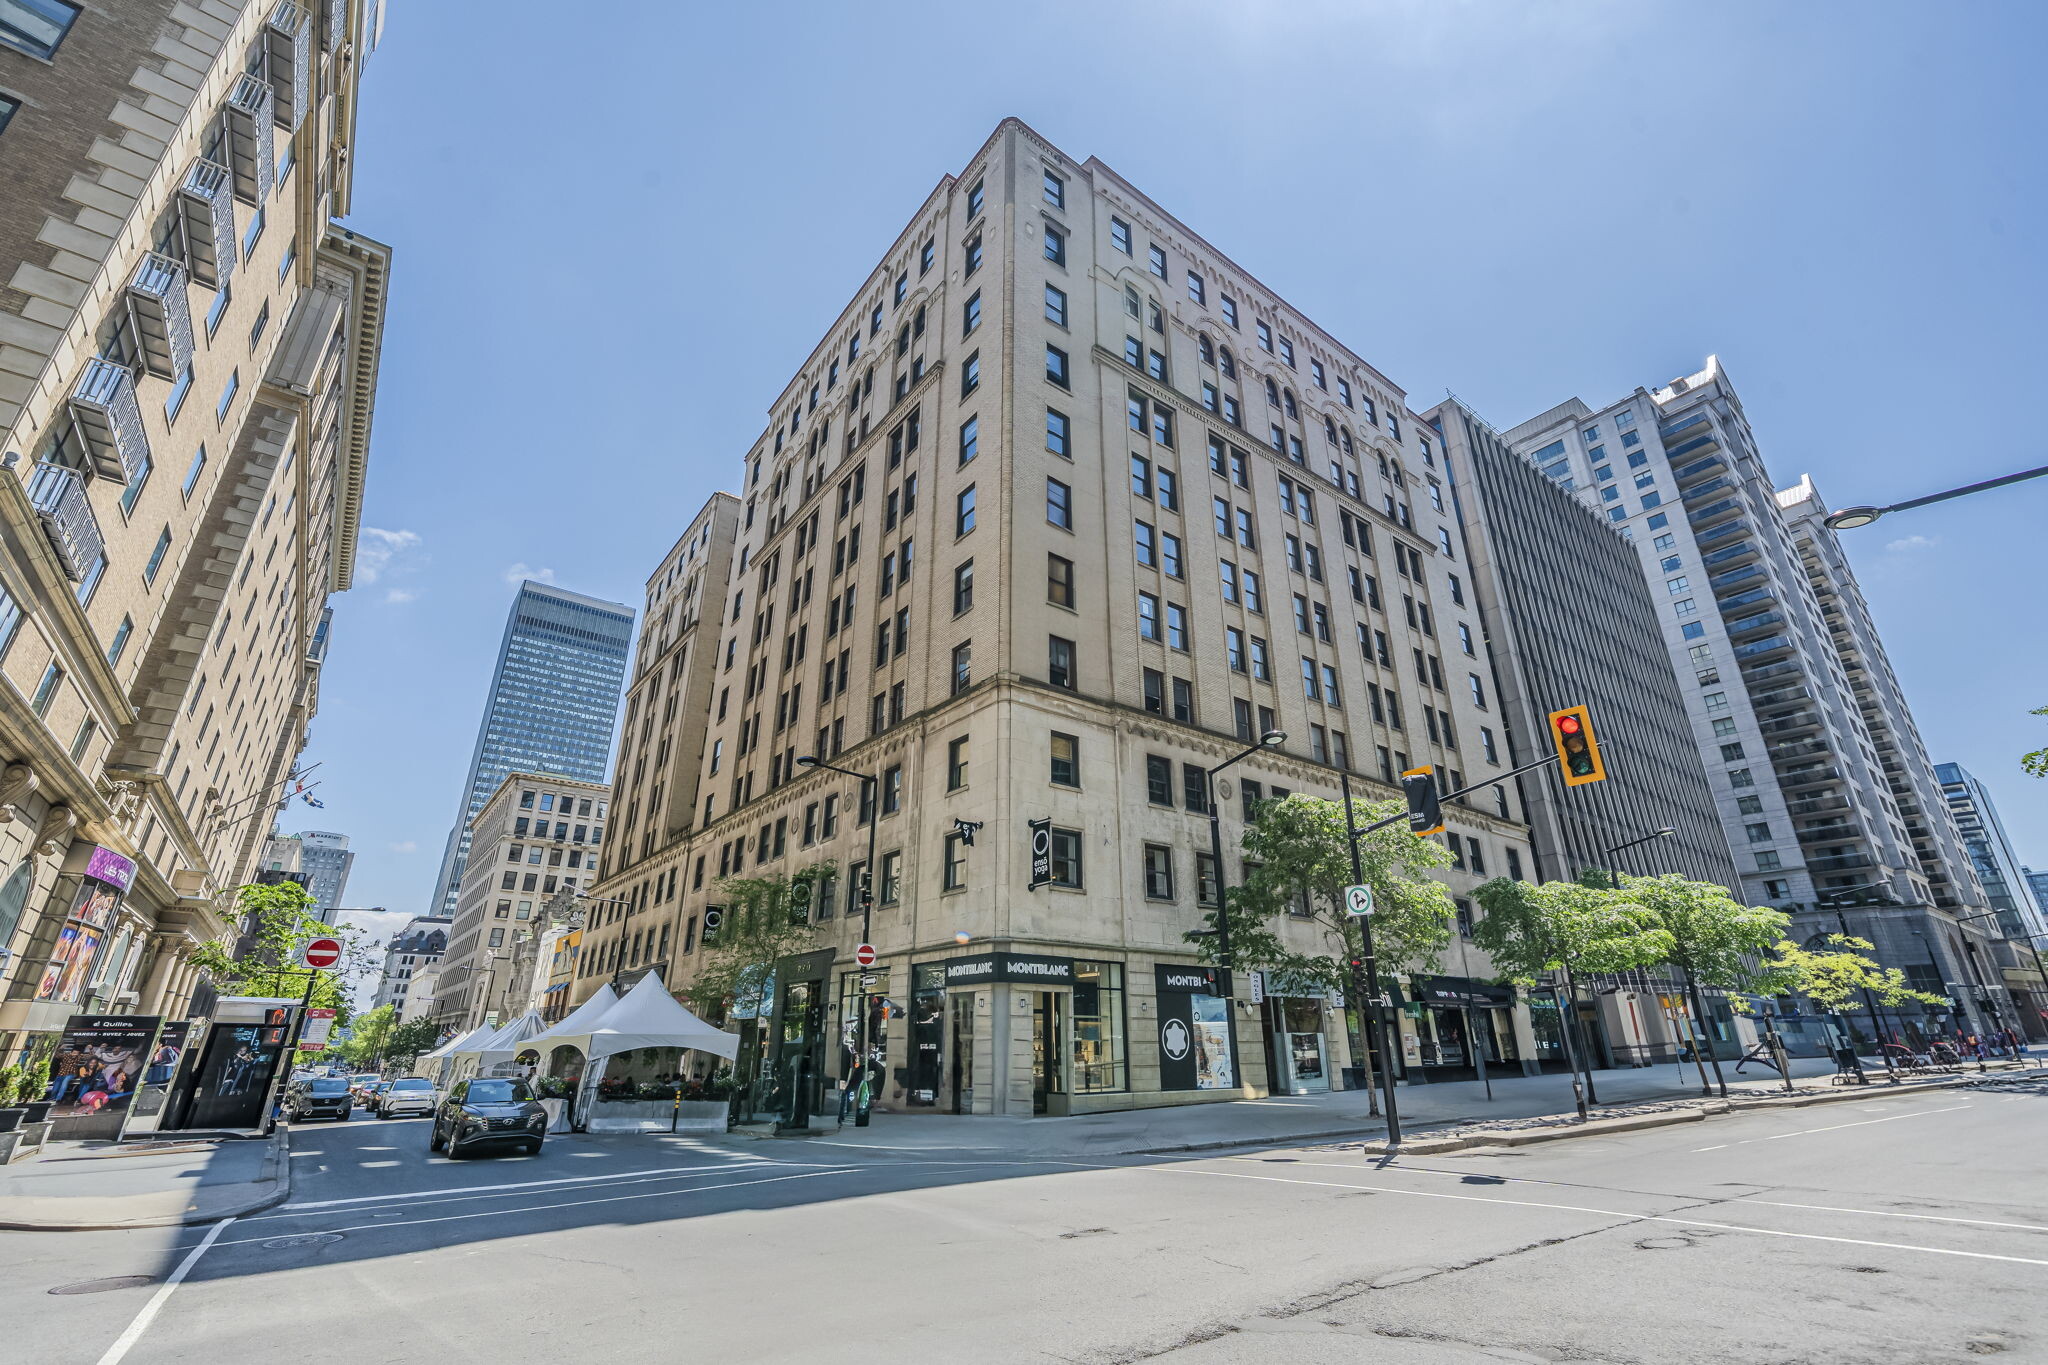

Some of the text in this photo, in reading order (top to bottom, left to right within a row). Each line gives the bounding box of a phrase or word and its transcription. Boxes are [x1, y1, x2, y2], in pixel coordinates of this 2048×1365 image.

[1034, 865, 1048, 876] yoga
[948, 962, 993, 977] MONTBLANC
[1007, 961, 1069, 976] MONTBLANC
